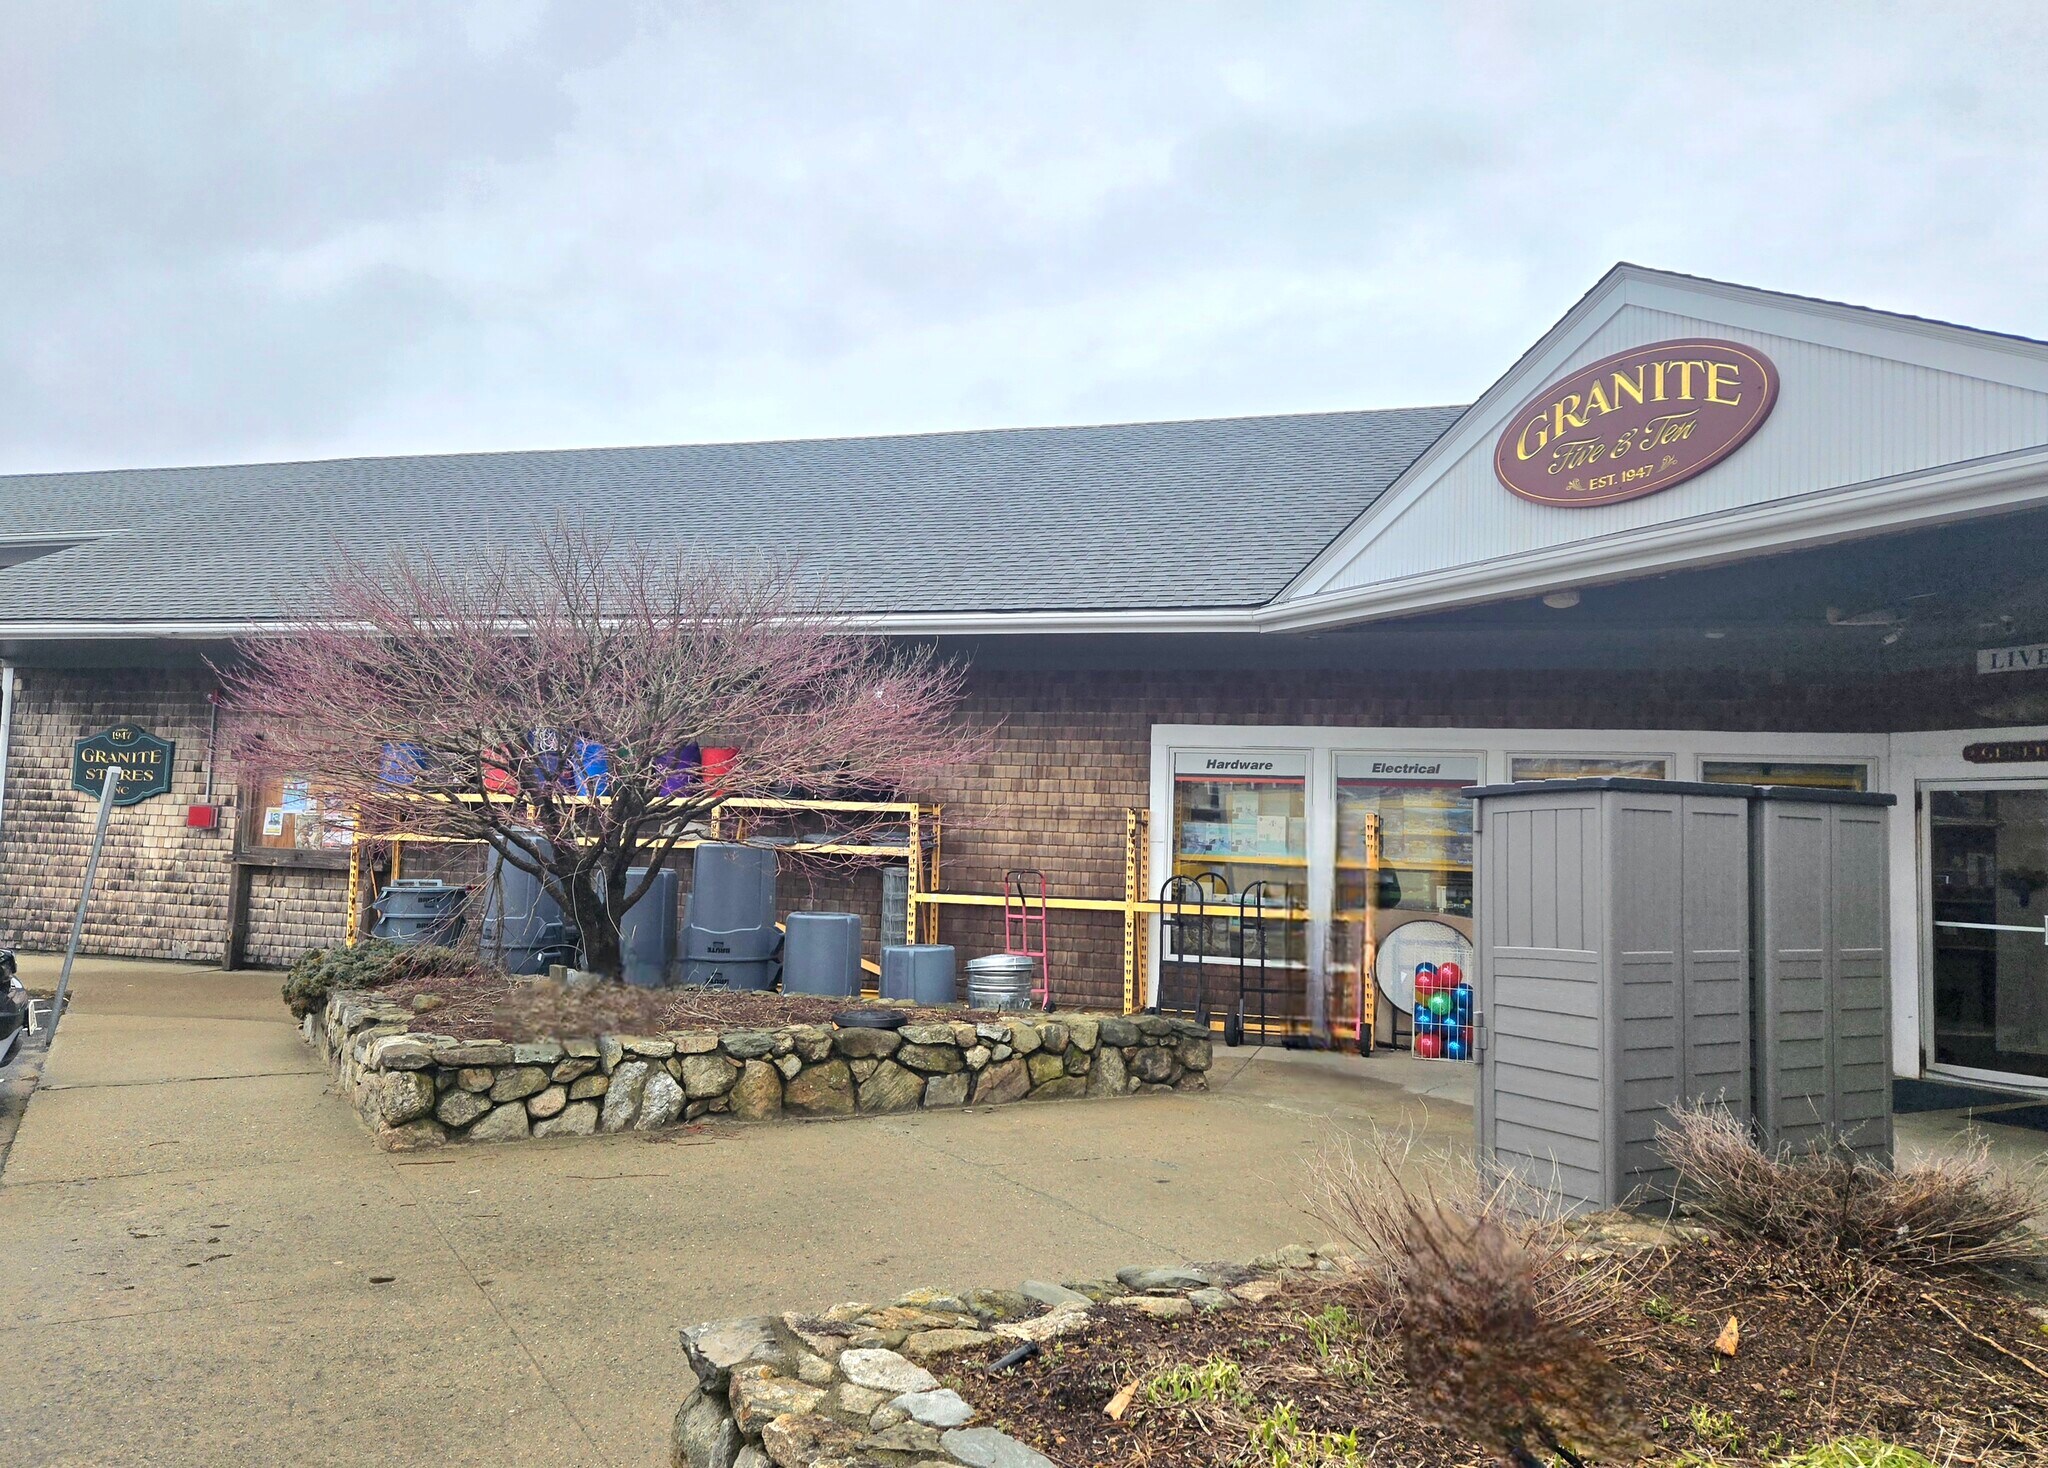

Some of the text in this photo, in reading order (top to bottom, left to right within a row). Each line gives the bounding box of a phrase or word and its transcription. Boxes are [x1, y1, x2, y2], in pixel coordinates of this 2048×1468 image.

[1517, 360, 1742, 461] GRANITE
[1548, 408, 1701, 475] Five & Ten
[1589, 465, 1654, 491] EST. 1947
[112, 731, 133, 740] 1947
[81, 747, 162, 764] GRANITE
[1206, 759, 1274, 771] Hardware
[1371, 763, 1441, 775] Electrical
[85, 767, 154, 782] STRES
